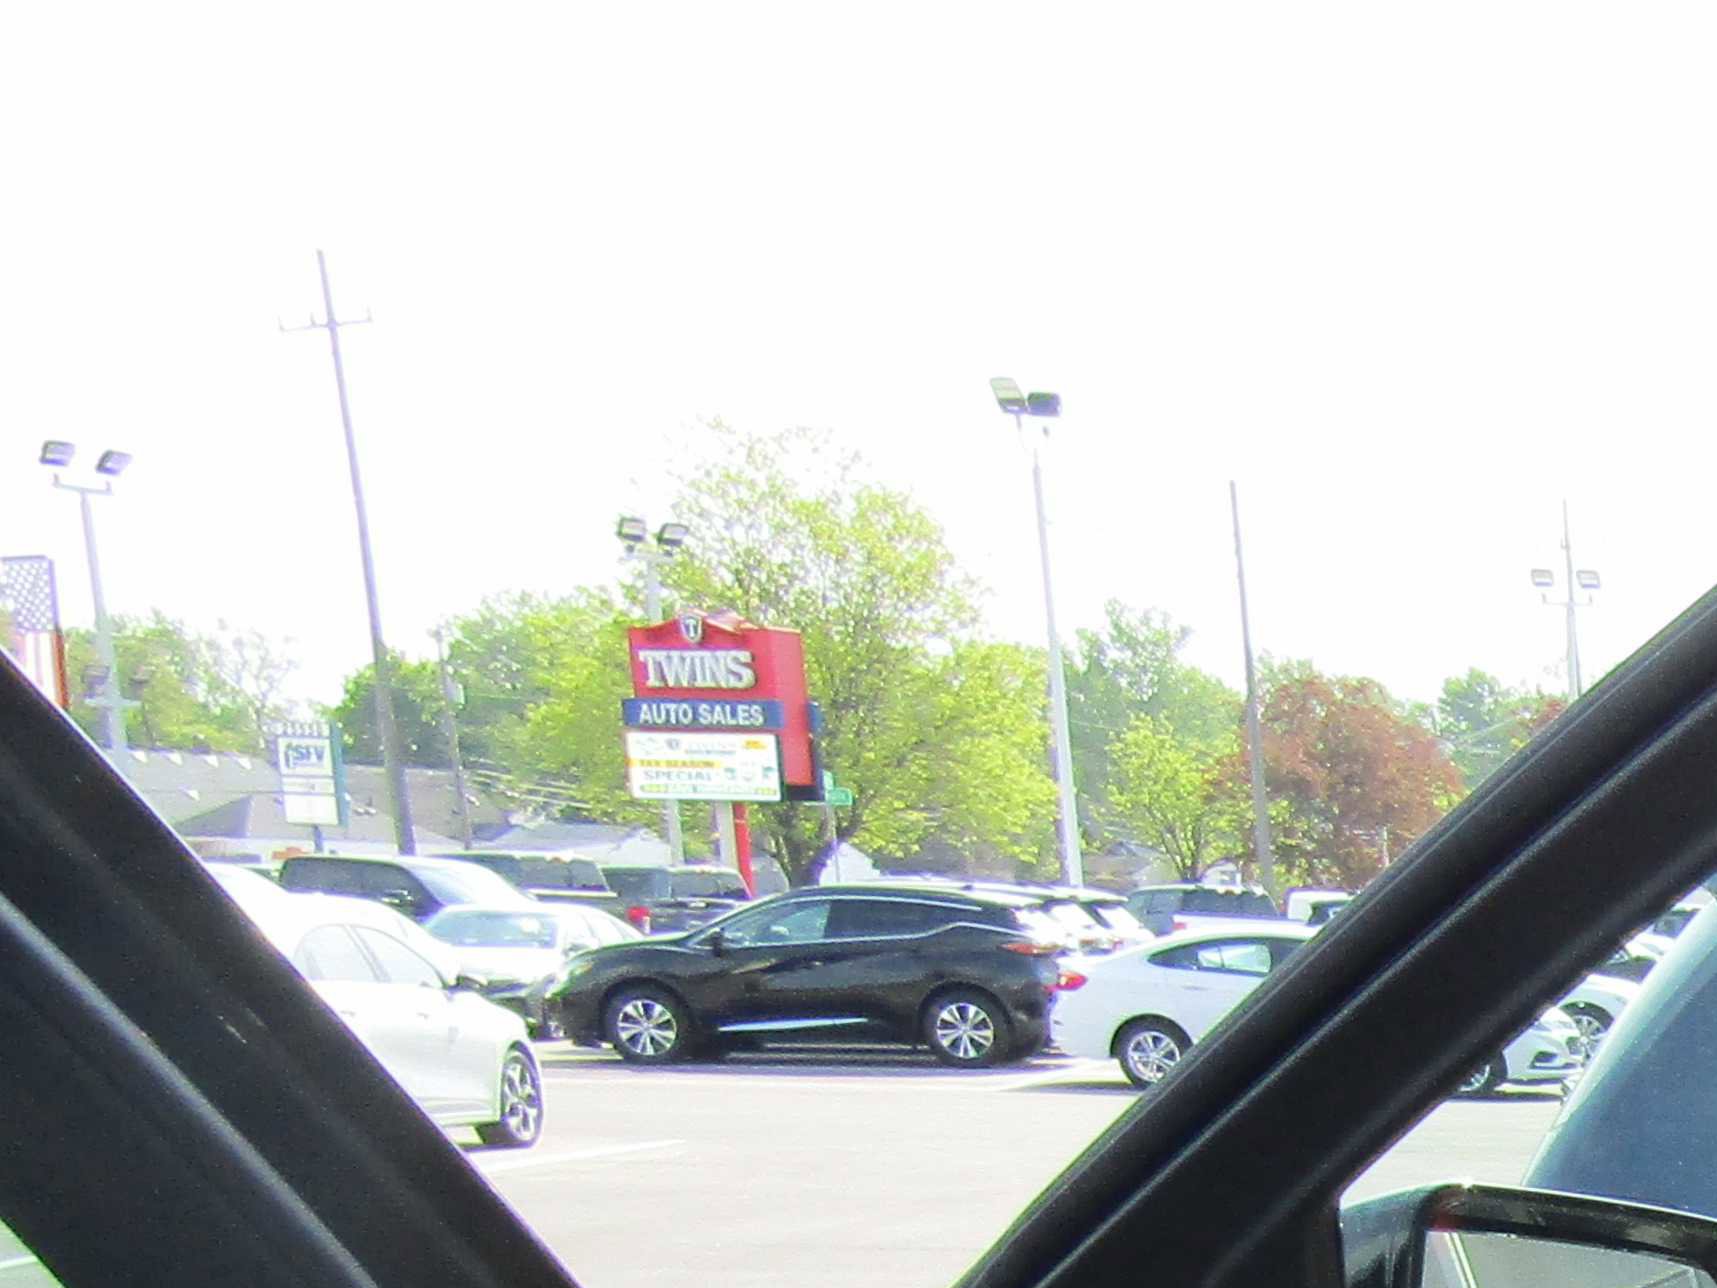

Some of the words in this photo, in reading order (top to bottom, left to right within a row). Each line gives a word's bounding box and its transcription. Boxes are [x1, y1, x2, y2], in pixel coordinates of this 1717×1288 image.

[638, 649, 757, 689] TWINS
[639, 703, 693, 725] AUTO
[699, 704, 764, 726] SALES
